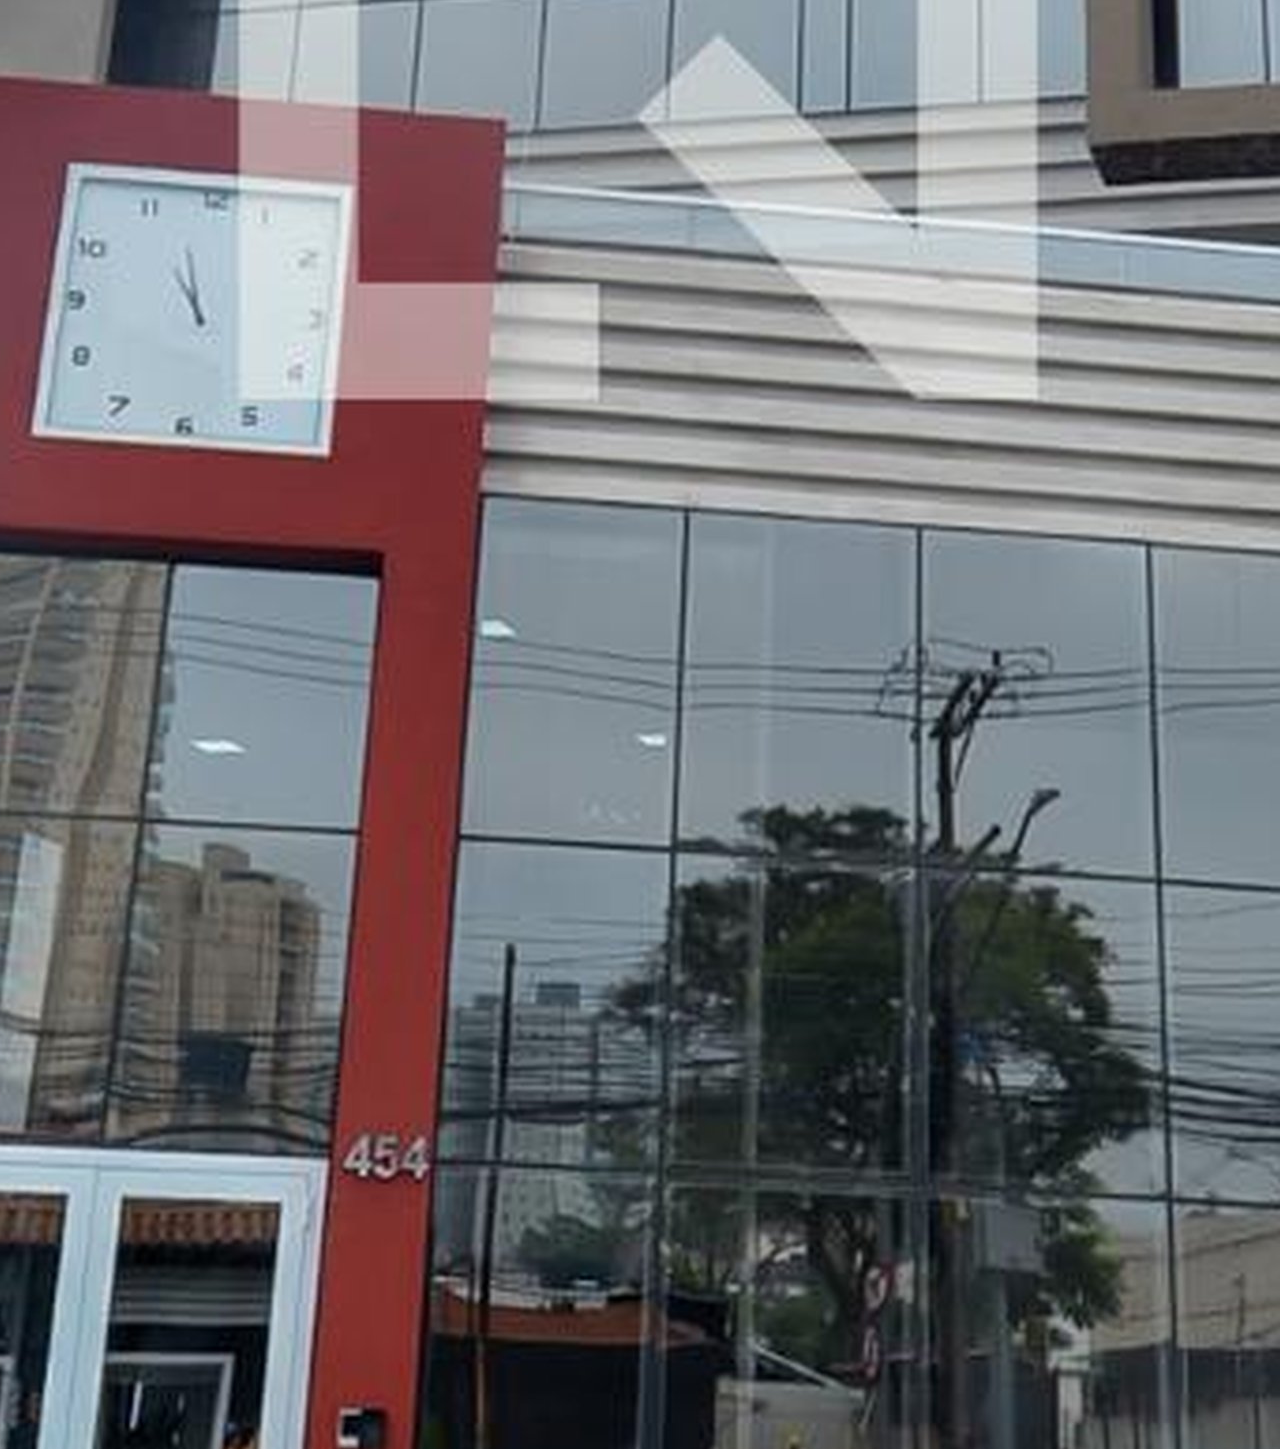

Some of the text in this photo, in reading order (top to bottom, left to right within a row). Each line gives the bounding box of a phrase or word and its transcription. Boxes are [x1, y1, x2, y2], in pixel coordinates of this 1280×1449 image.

[141, 199, 158, 217] 11
[78, 238, 106, 258] 10
[68, 290, 87, 310] 9
[72, 345, 90, 366] 8
[108, 395, 130, 417] 7
[241, 406, 259, 426] 5
[174, 417, 193, 436] 6
[343, 1132, 430, 1180] 454
